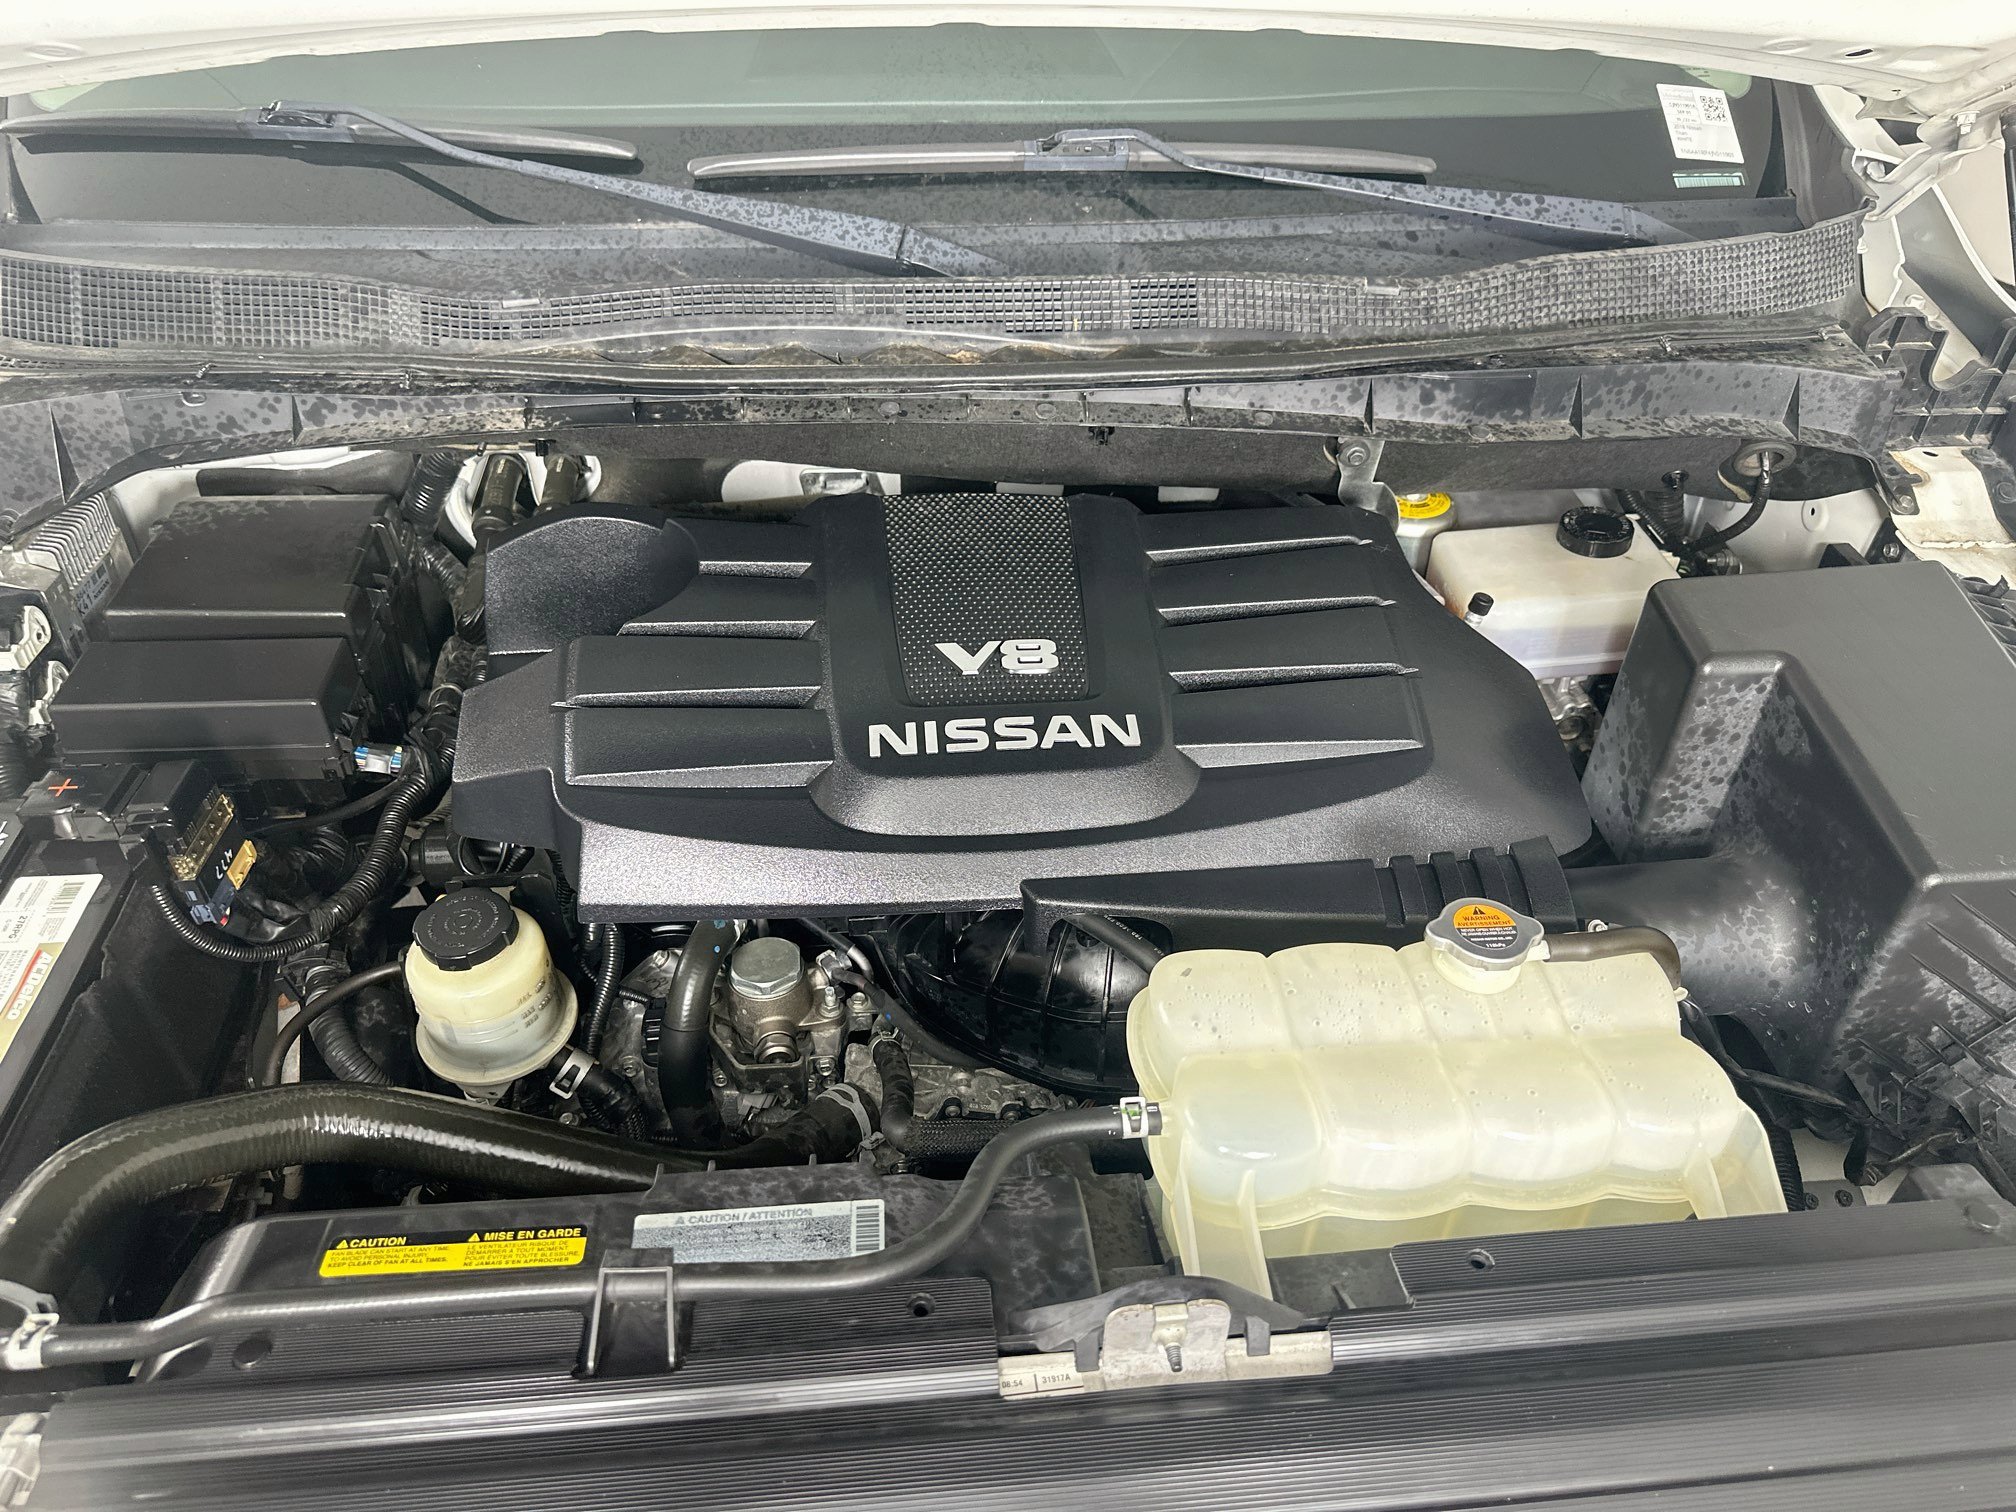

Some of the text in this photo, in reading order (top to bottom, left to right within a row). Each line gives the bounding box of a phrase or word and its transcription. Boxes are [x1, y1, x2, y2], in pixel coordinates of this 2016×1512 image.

[934, 638, 1059, 675] V8
[868, 713, 1141, 758] NISSAN
[7, 951, 54, 1020] ACDelco
[688, 1213, 740, 1224] CAUTION
[748, 1208, 812, 1220] ATTENTION
[350, 1237, 406, 1248] CAUTION
[484, 1228, 581, 1240] MISE EN GARDE
